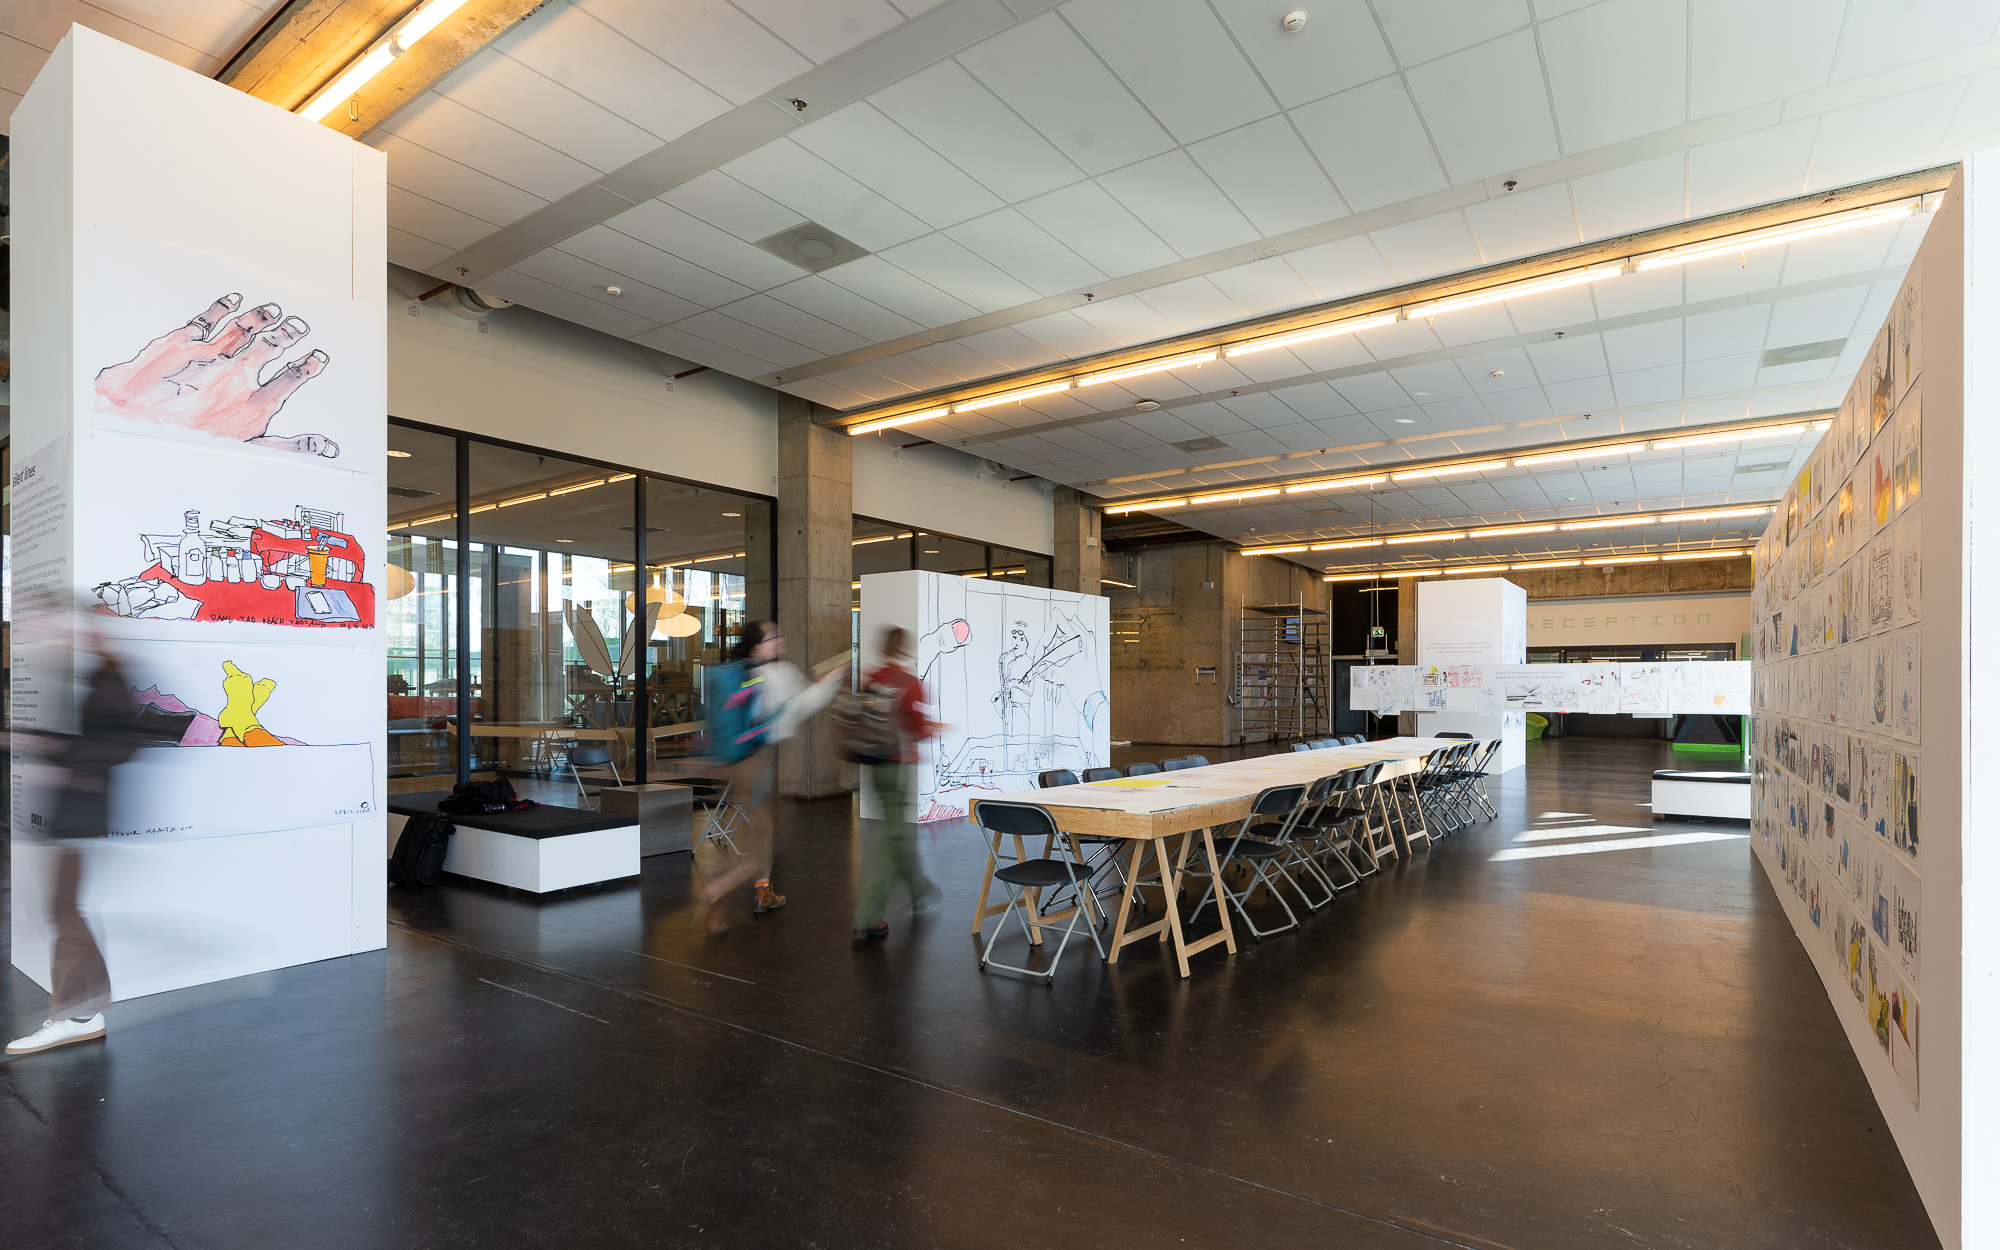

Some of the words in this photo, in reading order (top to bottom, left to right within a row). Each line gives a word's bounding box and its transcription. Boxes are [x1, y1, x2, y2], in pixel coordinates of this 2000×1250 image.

[12, 469, 24, 488] silent
[24, 465, 36, 481] lines
[210, 614, 233, 623] BANG
